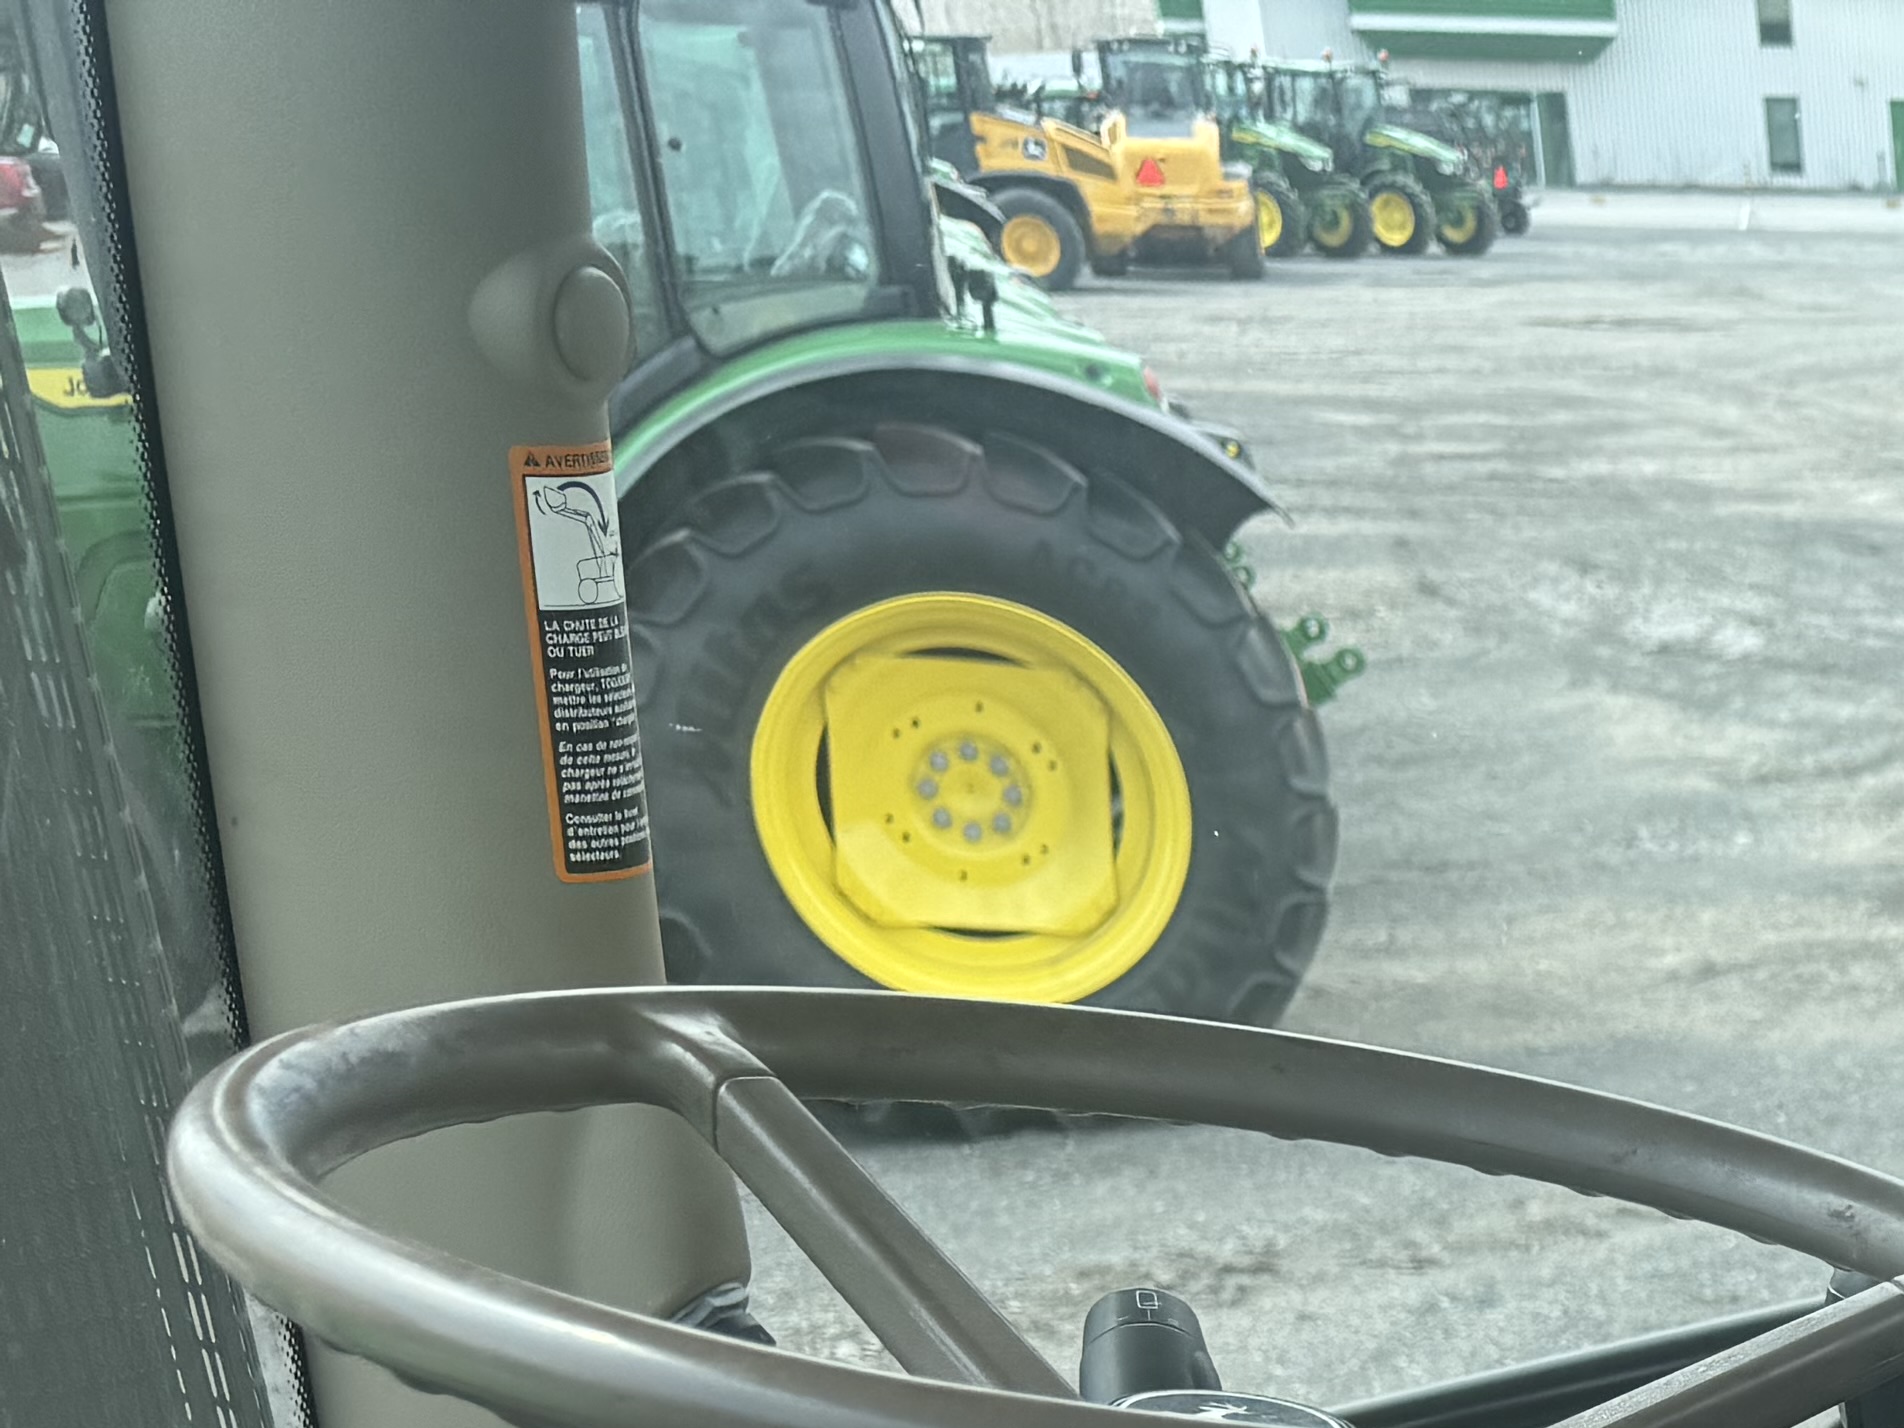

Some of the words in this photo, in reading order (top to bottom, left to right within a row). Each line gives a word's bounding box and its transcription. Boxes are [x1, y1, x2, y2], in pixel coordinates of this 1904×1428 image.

[543, 620, 560, 631] LA
[547, 645, 564, 658] OU
[555, 722, 570, 732] en
[558, 741, 573, 752] En
